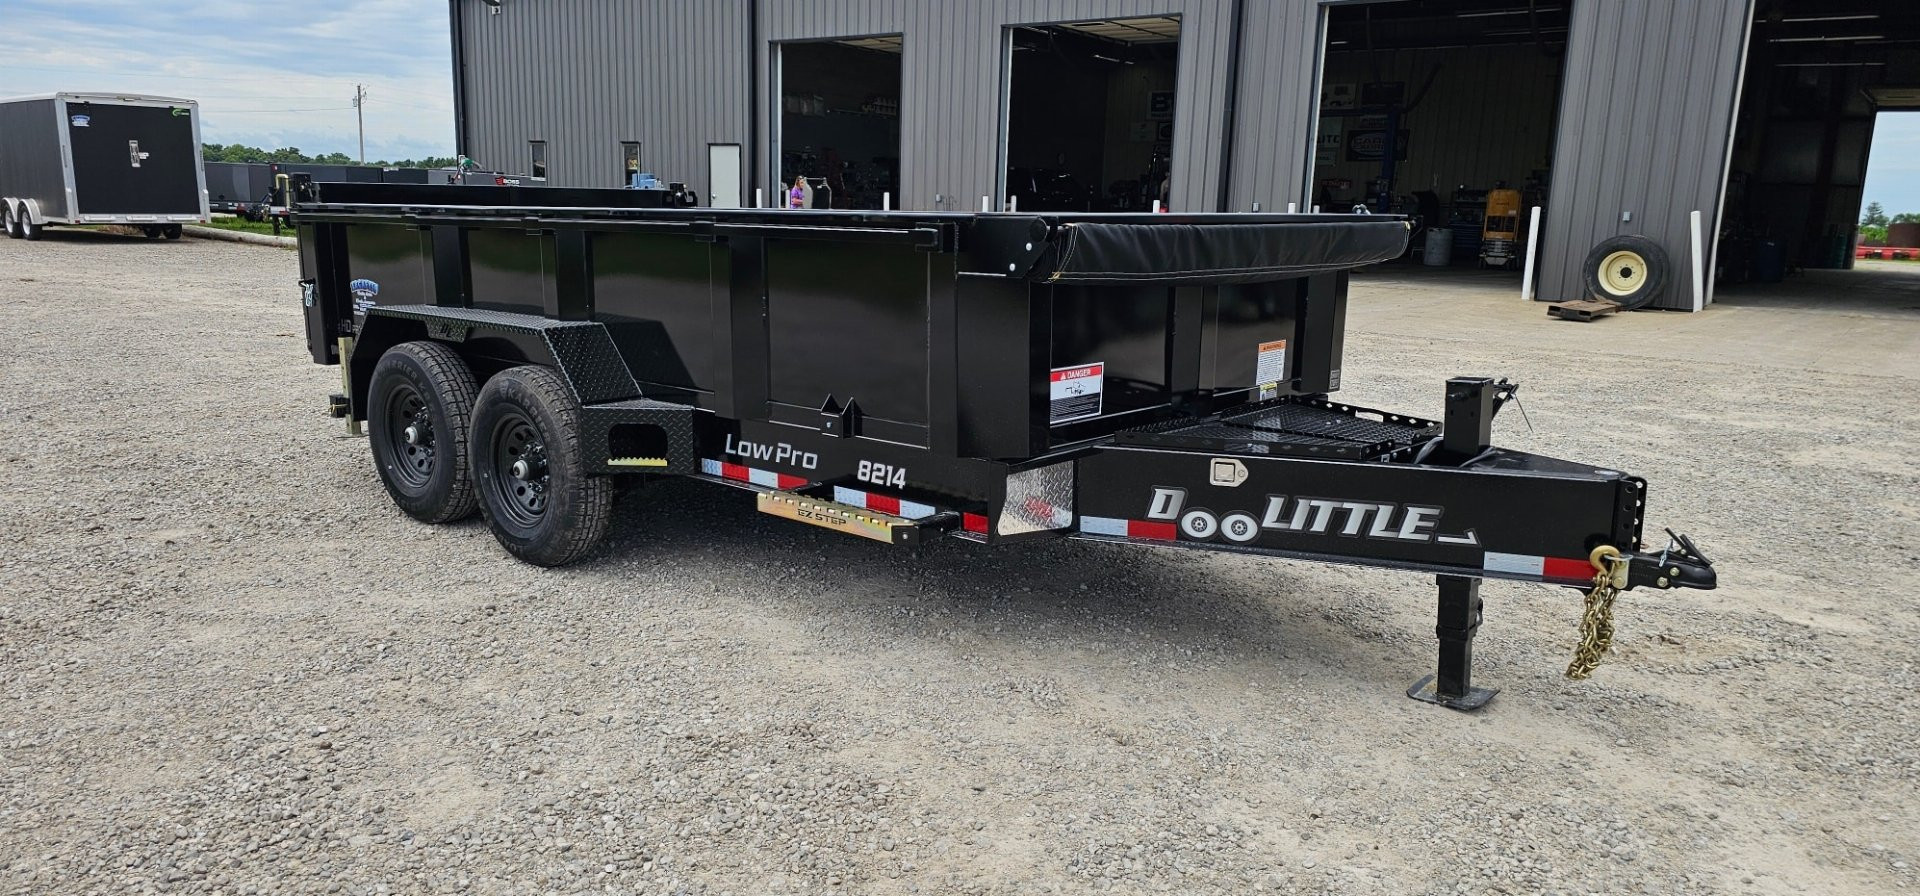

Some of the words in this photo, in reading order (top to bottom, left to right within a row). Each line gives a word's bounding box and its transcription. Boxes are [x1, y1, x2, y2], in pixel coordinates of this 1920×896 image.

[1067, 368, 1091, 379] DANGER
[857, 459, 906, 491] 8214
[797, 508, 813, 519] EZ
[815, 513, 847, 526] STEP
